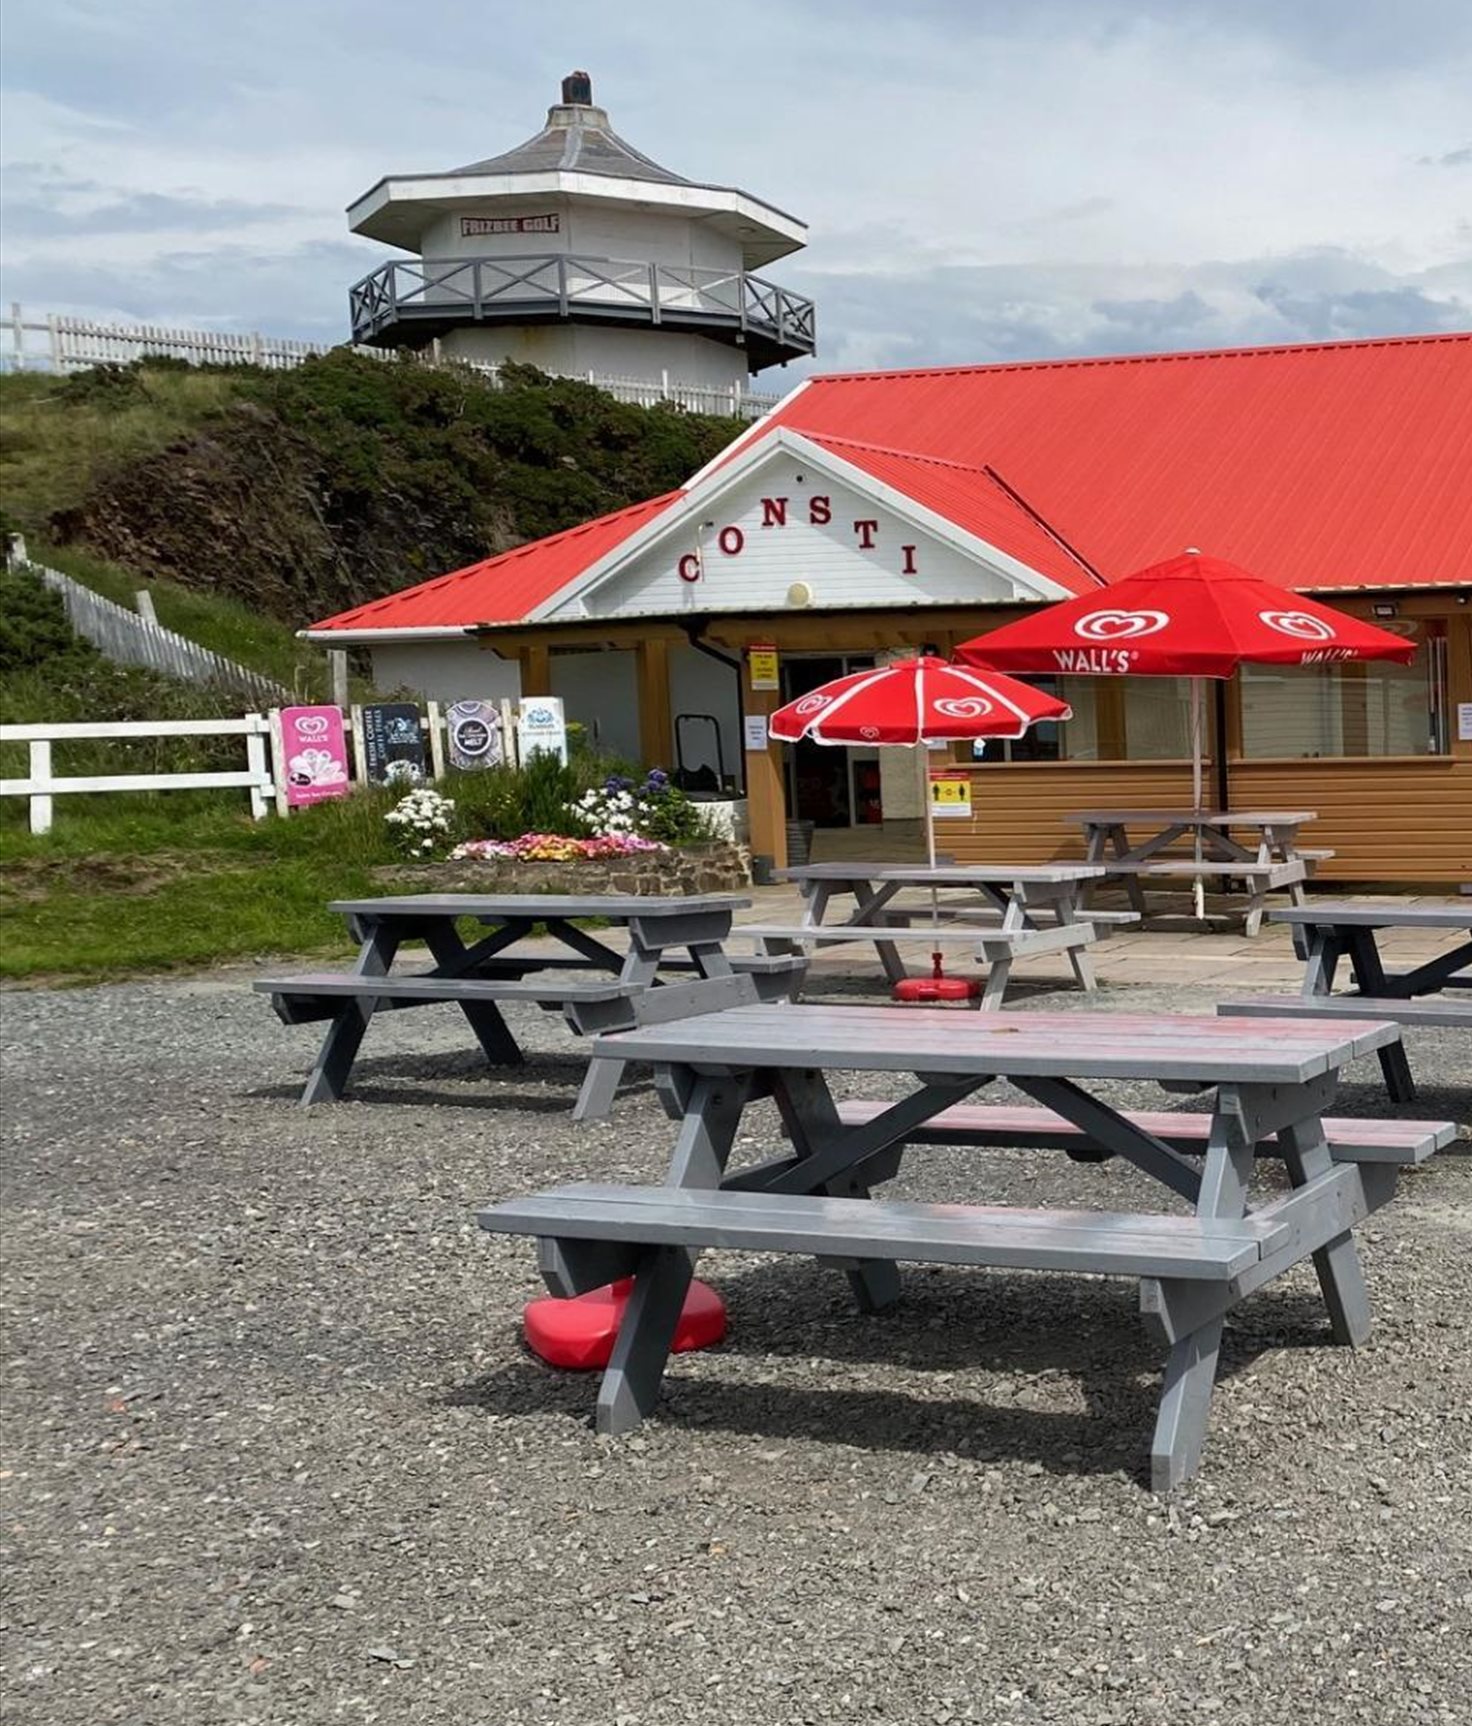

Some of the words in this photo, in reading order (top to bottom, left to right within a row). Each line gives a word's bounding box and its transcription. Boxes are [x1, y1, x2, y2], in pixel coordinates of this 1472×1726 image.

[462, 219, 519, 235] FRIZBEE
[522, 215, 559, 232] GOLF
[678, 496, 917, 582] CONSTI
[1052, 649, 1130, 673] WALL'S
